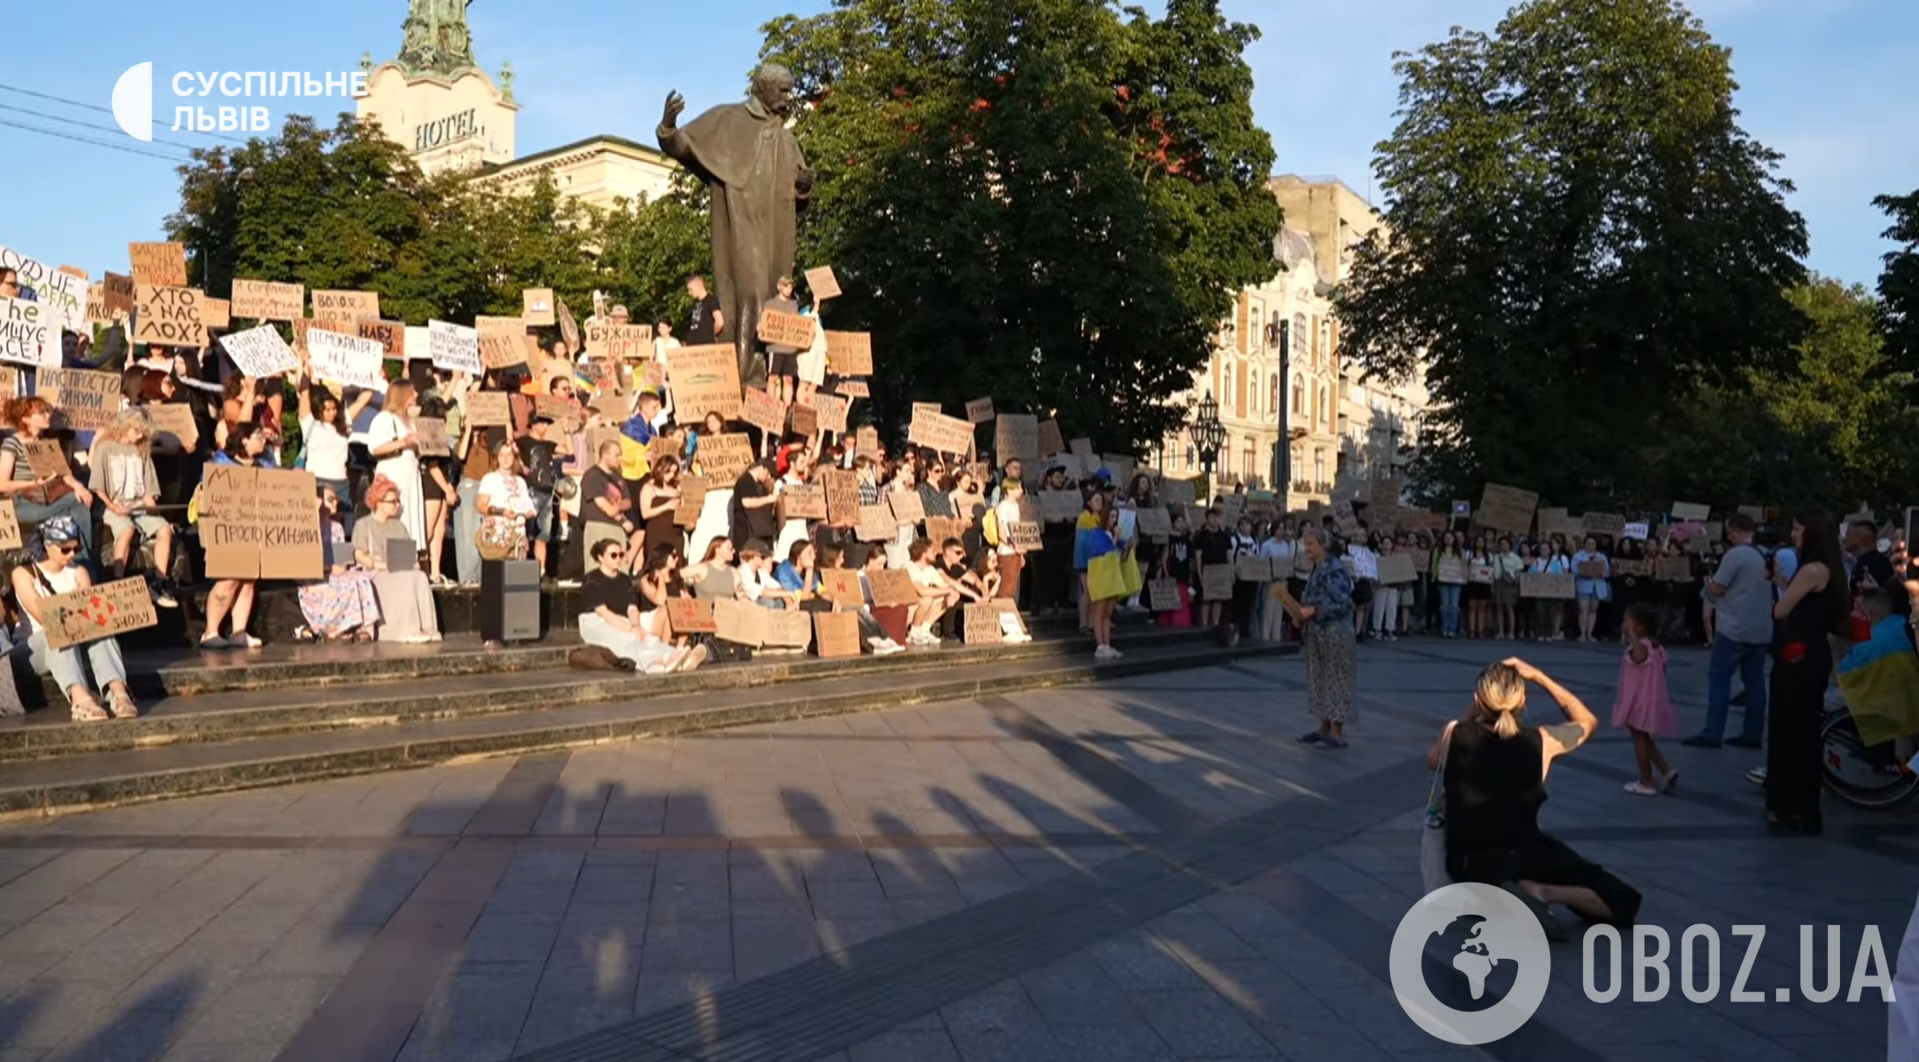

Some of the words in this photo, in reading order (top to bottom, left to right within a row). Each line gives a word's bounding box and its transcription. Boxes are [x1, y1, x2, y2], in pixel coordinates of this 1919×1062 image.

[416, 108, 480, 151] HOTEL
[150, 286, 195, 305] ХТО
[161, 305, 201, 320] НАС
[140, 321, 203, 343] ЛОХ?
[359, 324, 392, 340] НАБУ
[40, 370, 67, 389] НАС
[69, 370, 121, 394] ПРОСТО
[58, 388, 103, 408] КИНУЛИ
[215, 523, 262, 545] ПРОСТО
[264, 524, 319, 548] КИНУЛИ
[112, 612, 151, 630] ЗНОВУ
